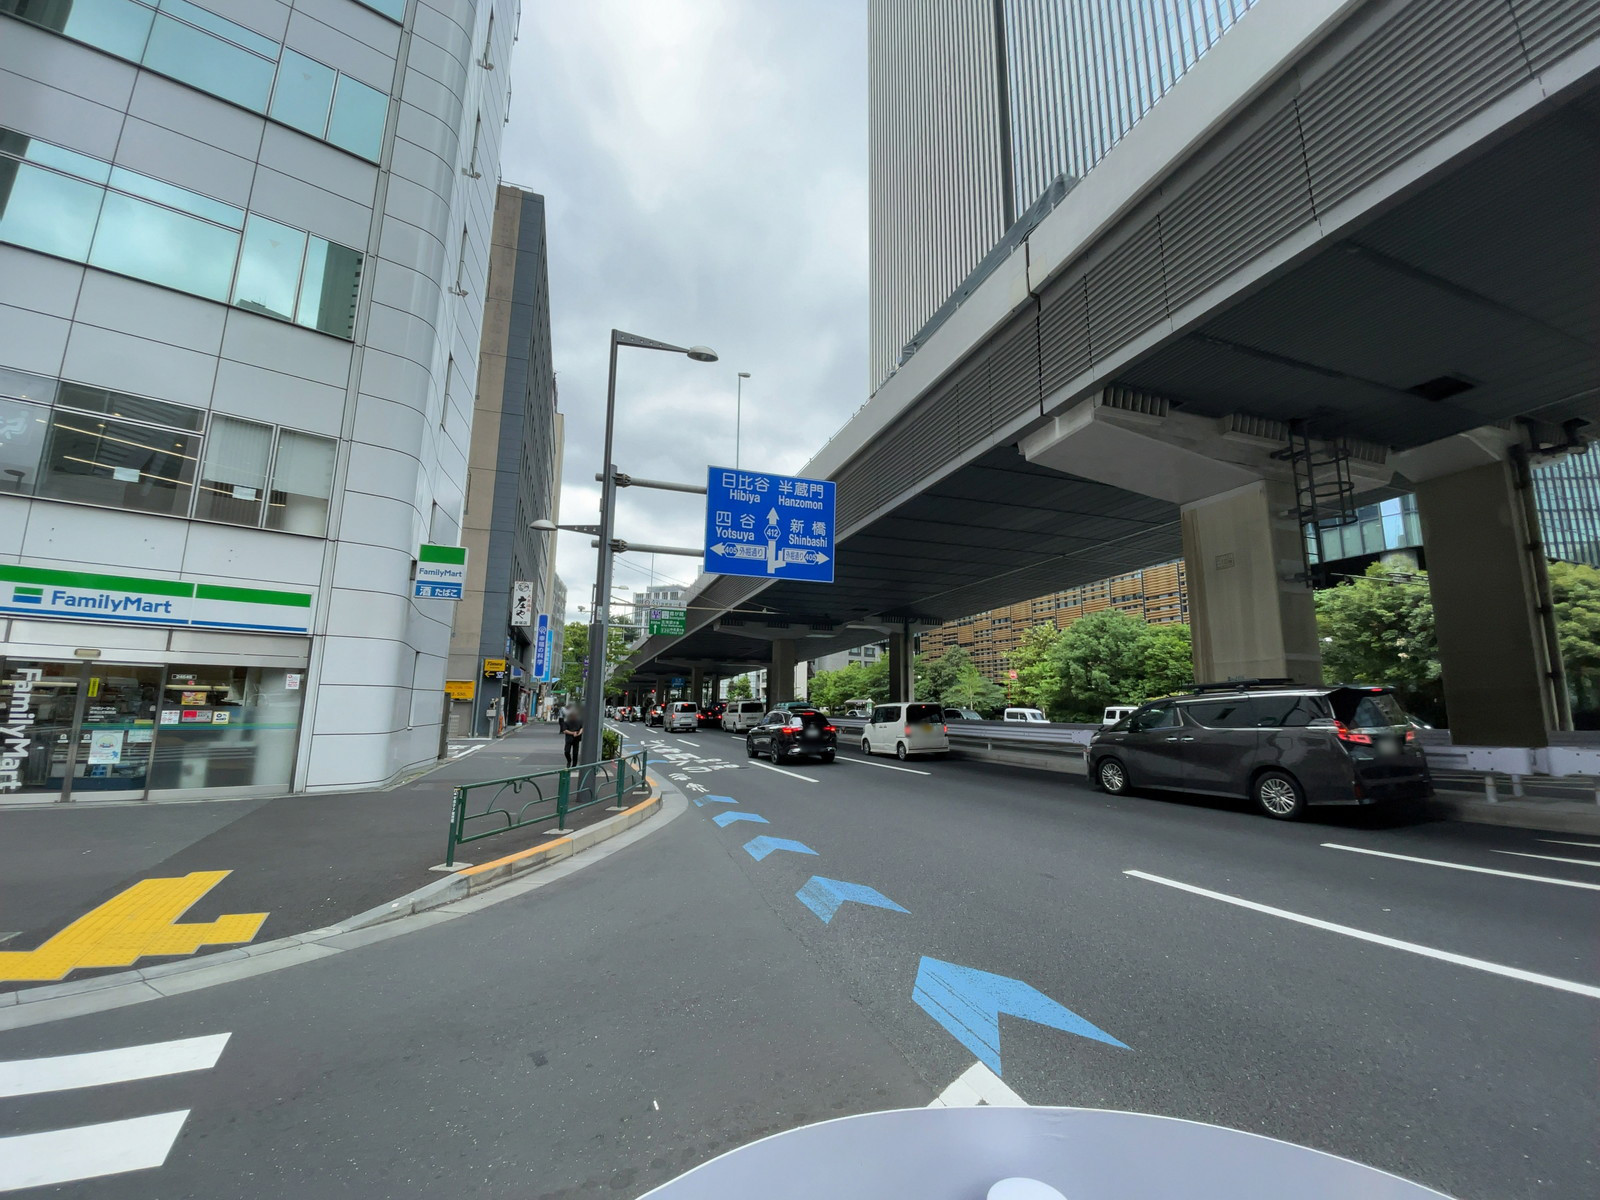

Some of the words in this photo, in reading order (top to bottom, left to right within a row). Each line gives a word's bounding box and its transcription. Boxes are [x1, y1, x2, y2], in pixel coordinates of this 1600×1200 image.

[722, 472, 770, 492] 日比谷
[778, 480, 824, 499] 半蔵門
[729, 489, 760, 504] Hibiya
[778, 495, 823, 510] Hanzomon
[715, 526, 755, 542] Yotsuya
[766, 529, 779, 537] 412
[788, 533, 828, 548] Shinbashi
[724, 546, 737, 554] 405
[739, 546, 764, 558] 外堀通り
[419, 567, 462, 578] FamilyMart
[51, 590, 172, 613] FamilyMart
[419, 586, 431, 596] 酒
[434, 588, 458, 597] たばこ
[514, 595, 527, 619] 庄や
[0, 668, 43, 790] FamilyMart
